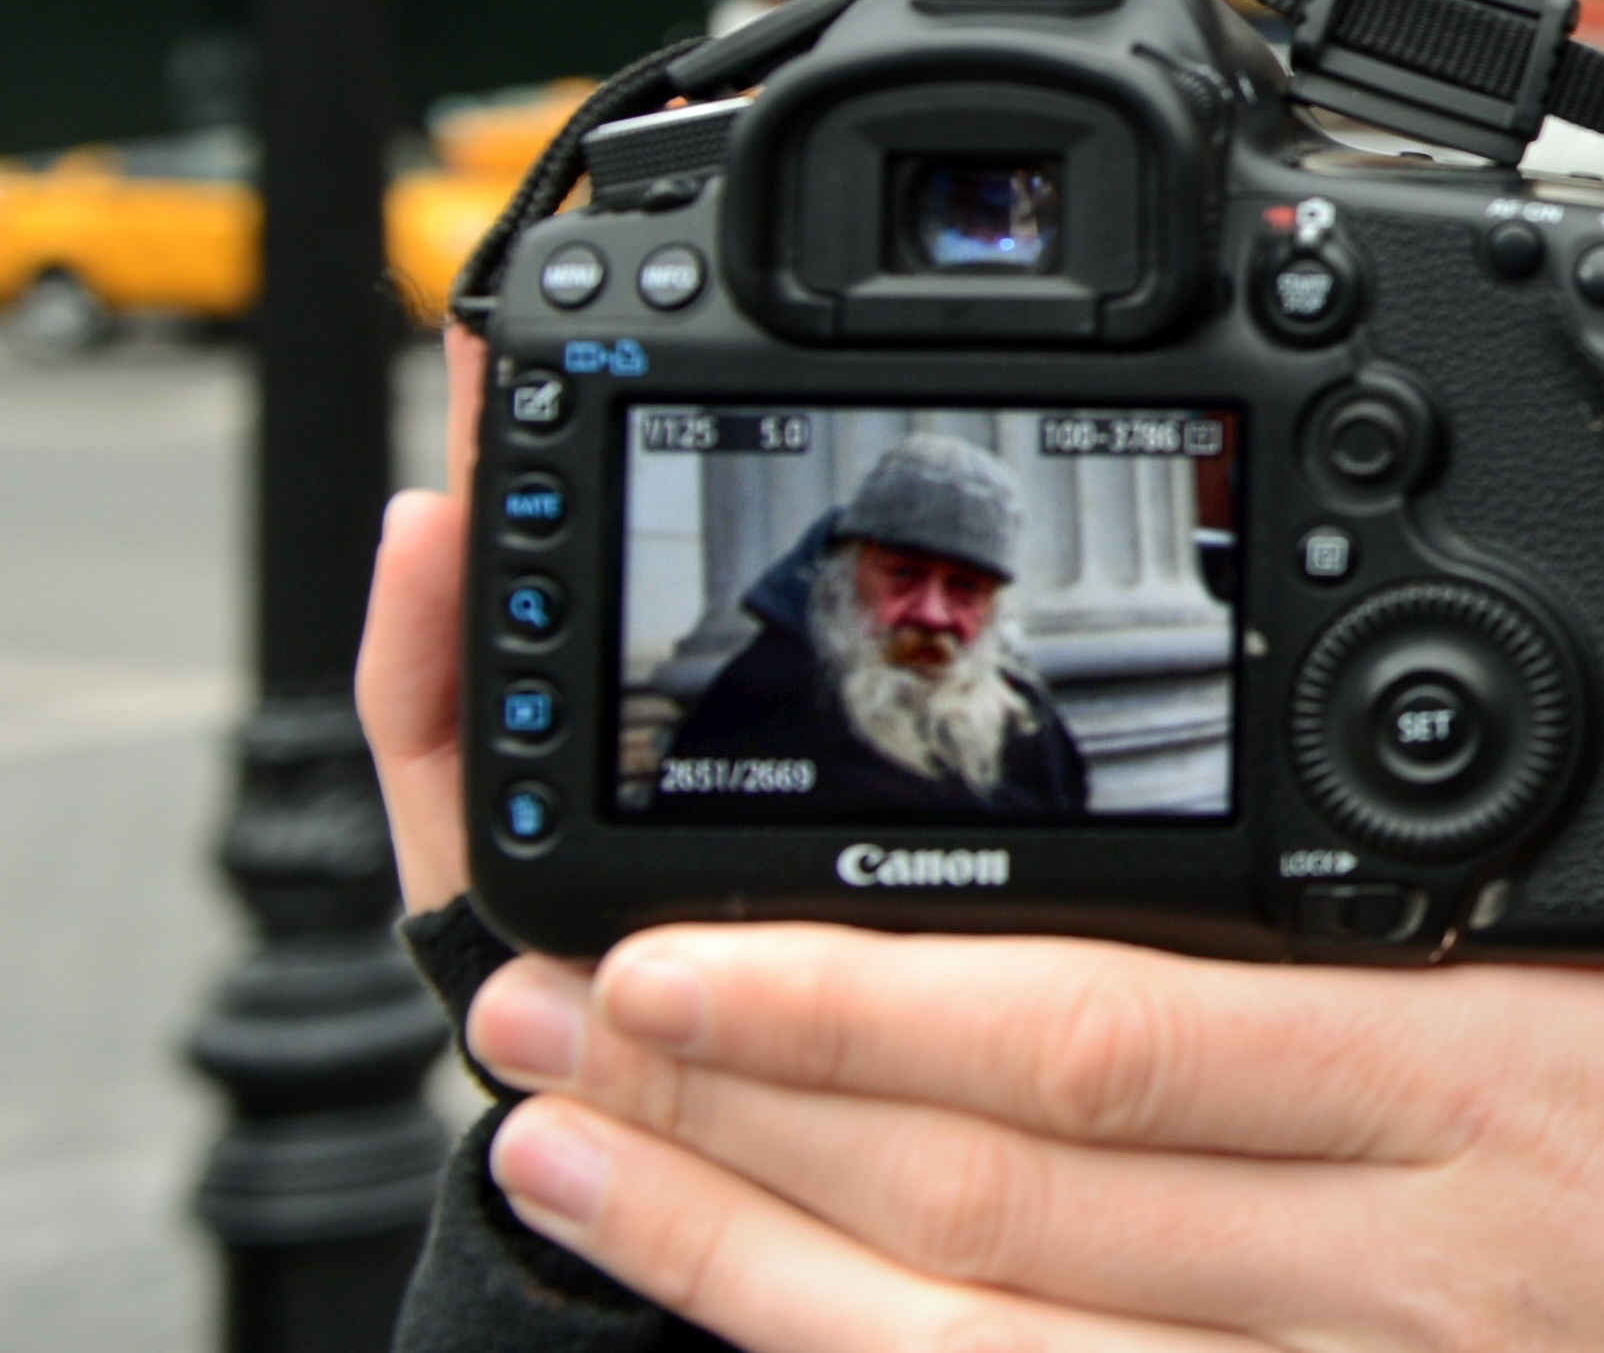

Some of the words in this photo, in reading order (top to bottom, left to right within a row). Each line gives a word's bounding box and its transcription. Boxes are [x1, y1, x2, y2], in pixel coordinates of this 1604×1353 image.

[506, 492, 562, 519] RATE
[1397, 709, 1455, 743] SET
[661, 758, 817, 792] 2651/2669
[836, 842, 1010, 887] Canon
[1280, 849, 1336, 877] LOCK
